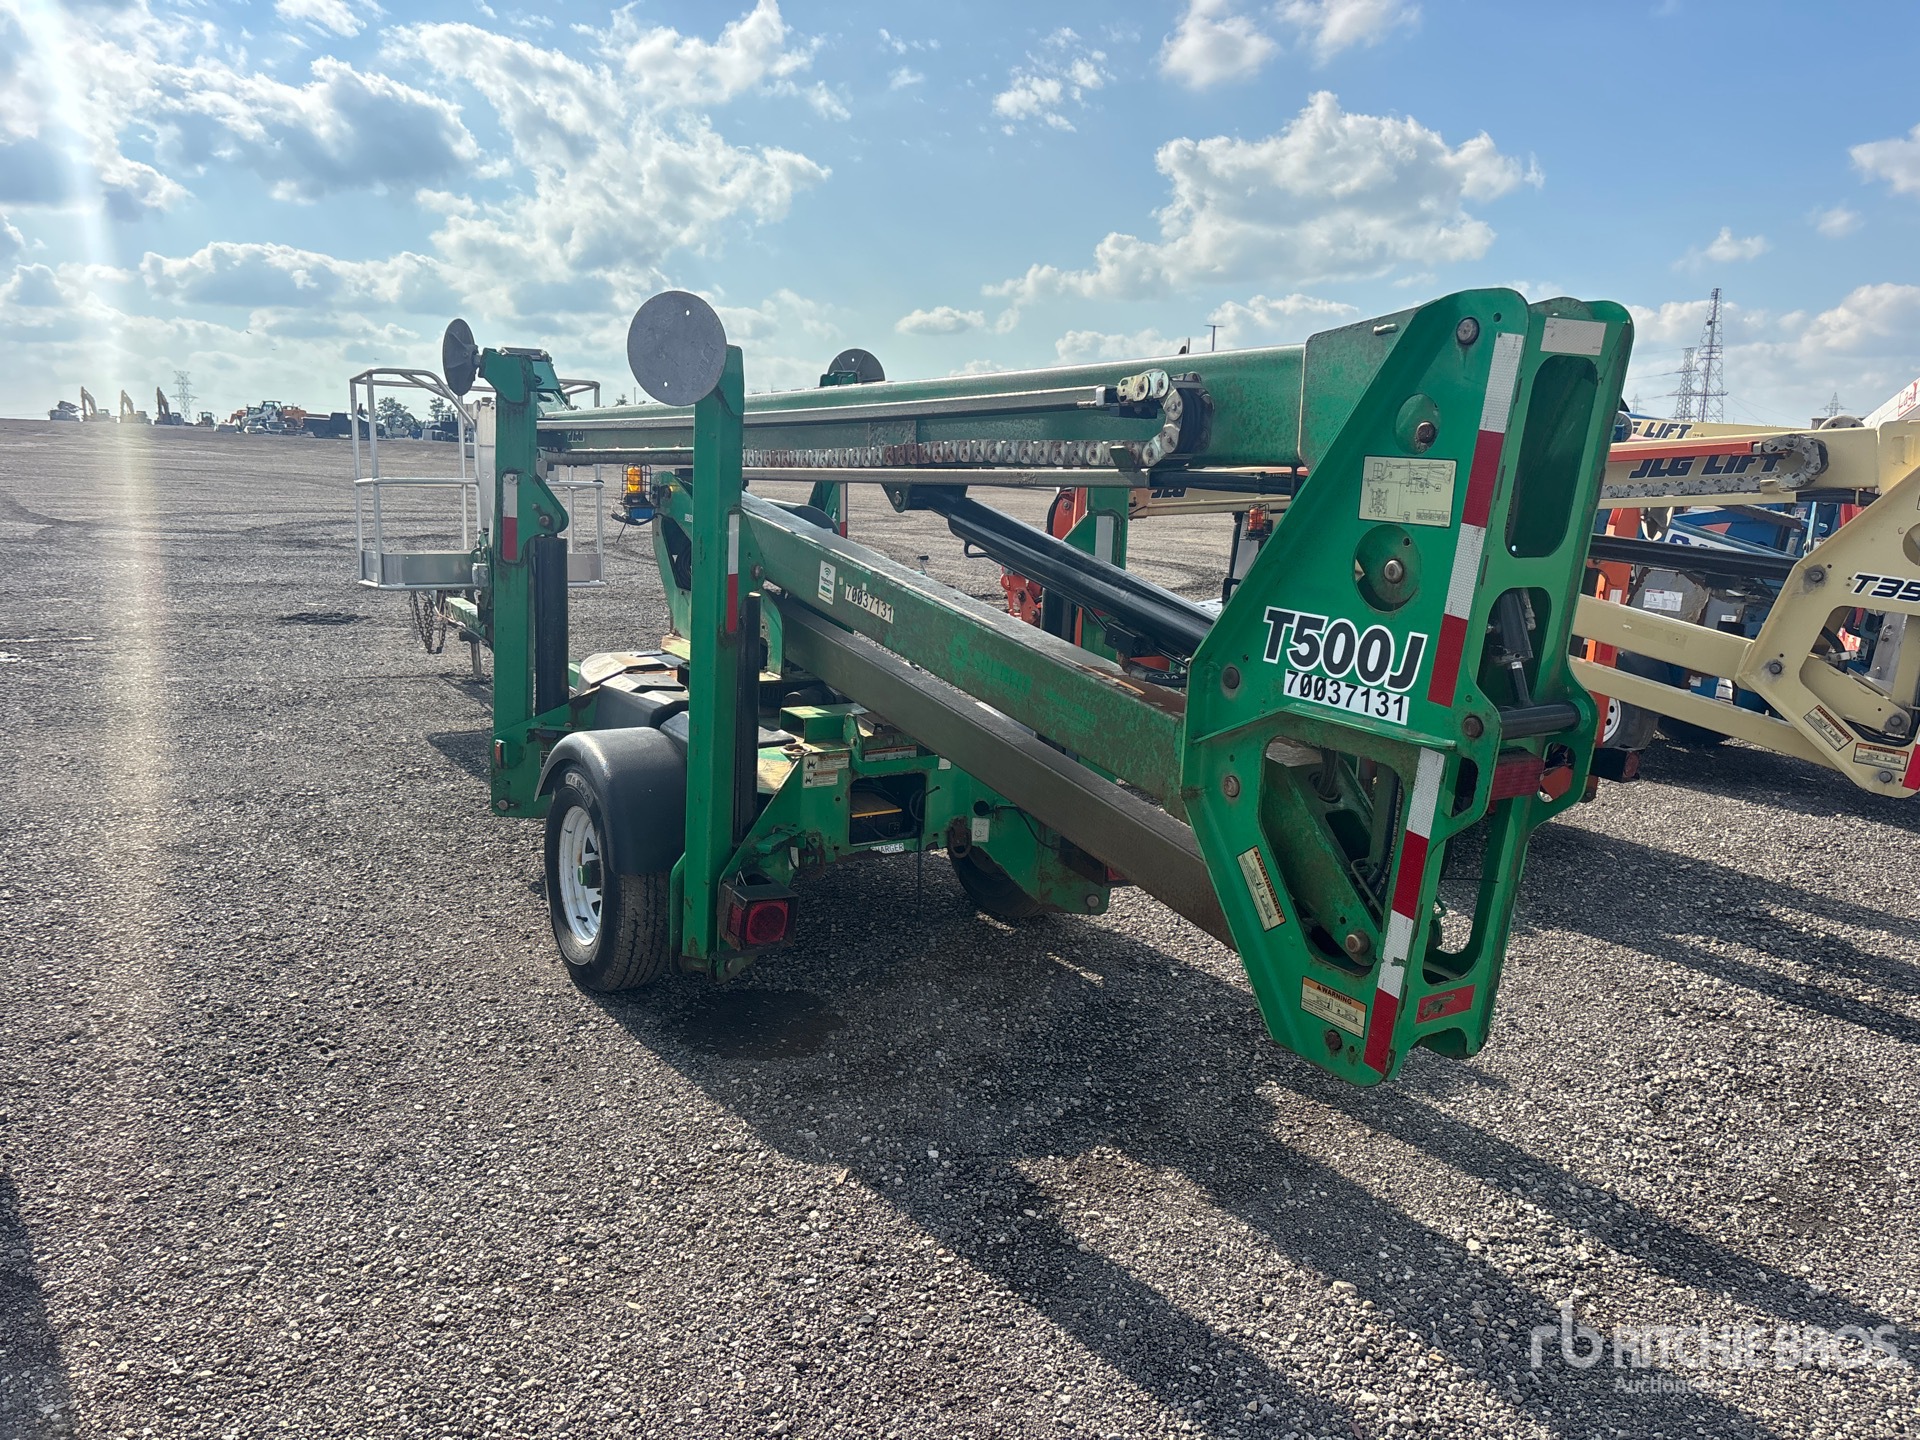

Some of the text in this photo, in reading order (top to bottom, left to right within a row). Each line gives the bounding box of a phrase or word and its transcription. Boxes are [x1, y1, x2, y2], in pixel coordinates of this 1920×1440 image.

[1643, 422, 1693, 439] LIFT
[1628, 453, 1787, 479] JLG LIFT
[846, 584, 893, 622] 70037131
[1264, 607, 1427, 691] T500J
[1286, 669, 1405, 722] 70037131
[1321, 985, 1352, 1005] WARNING
